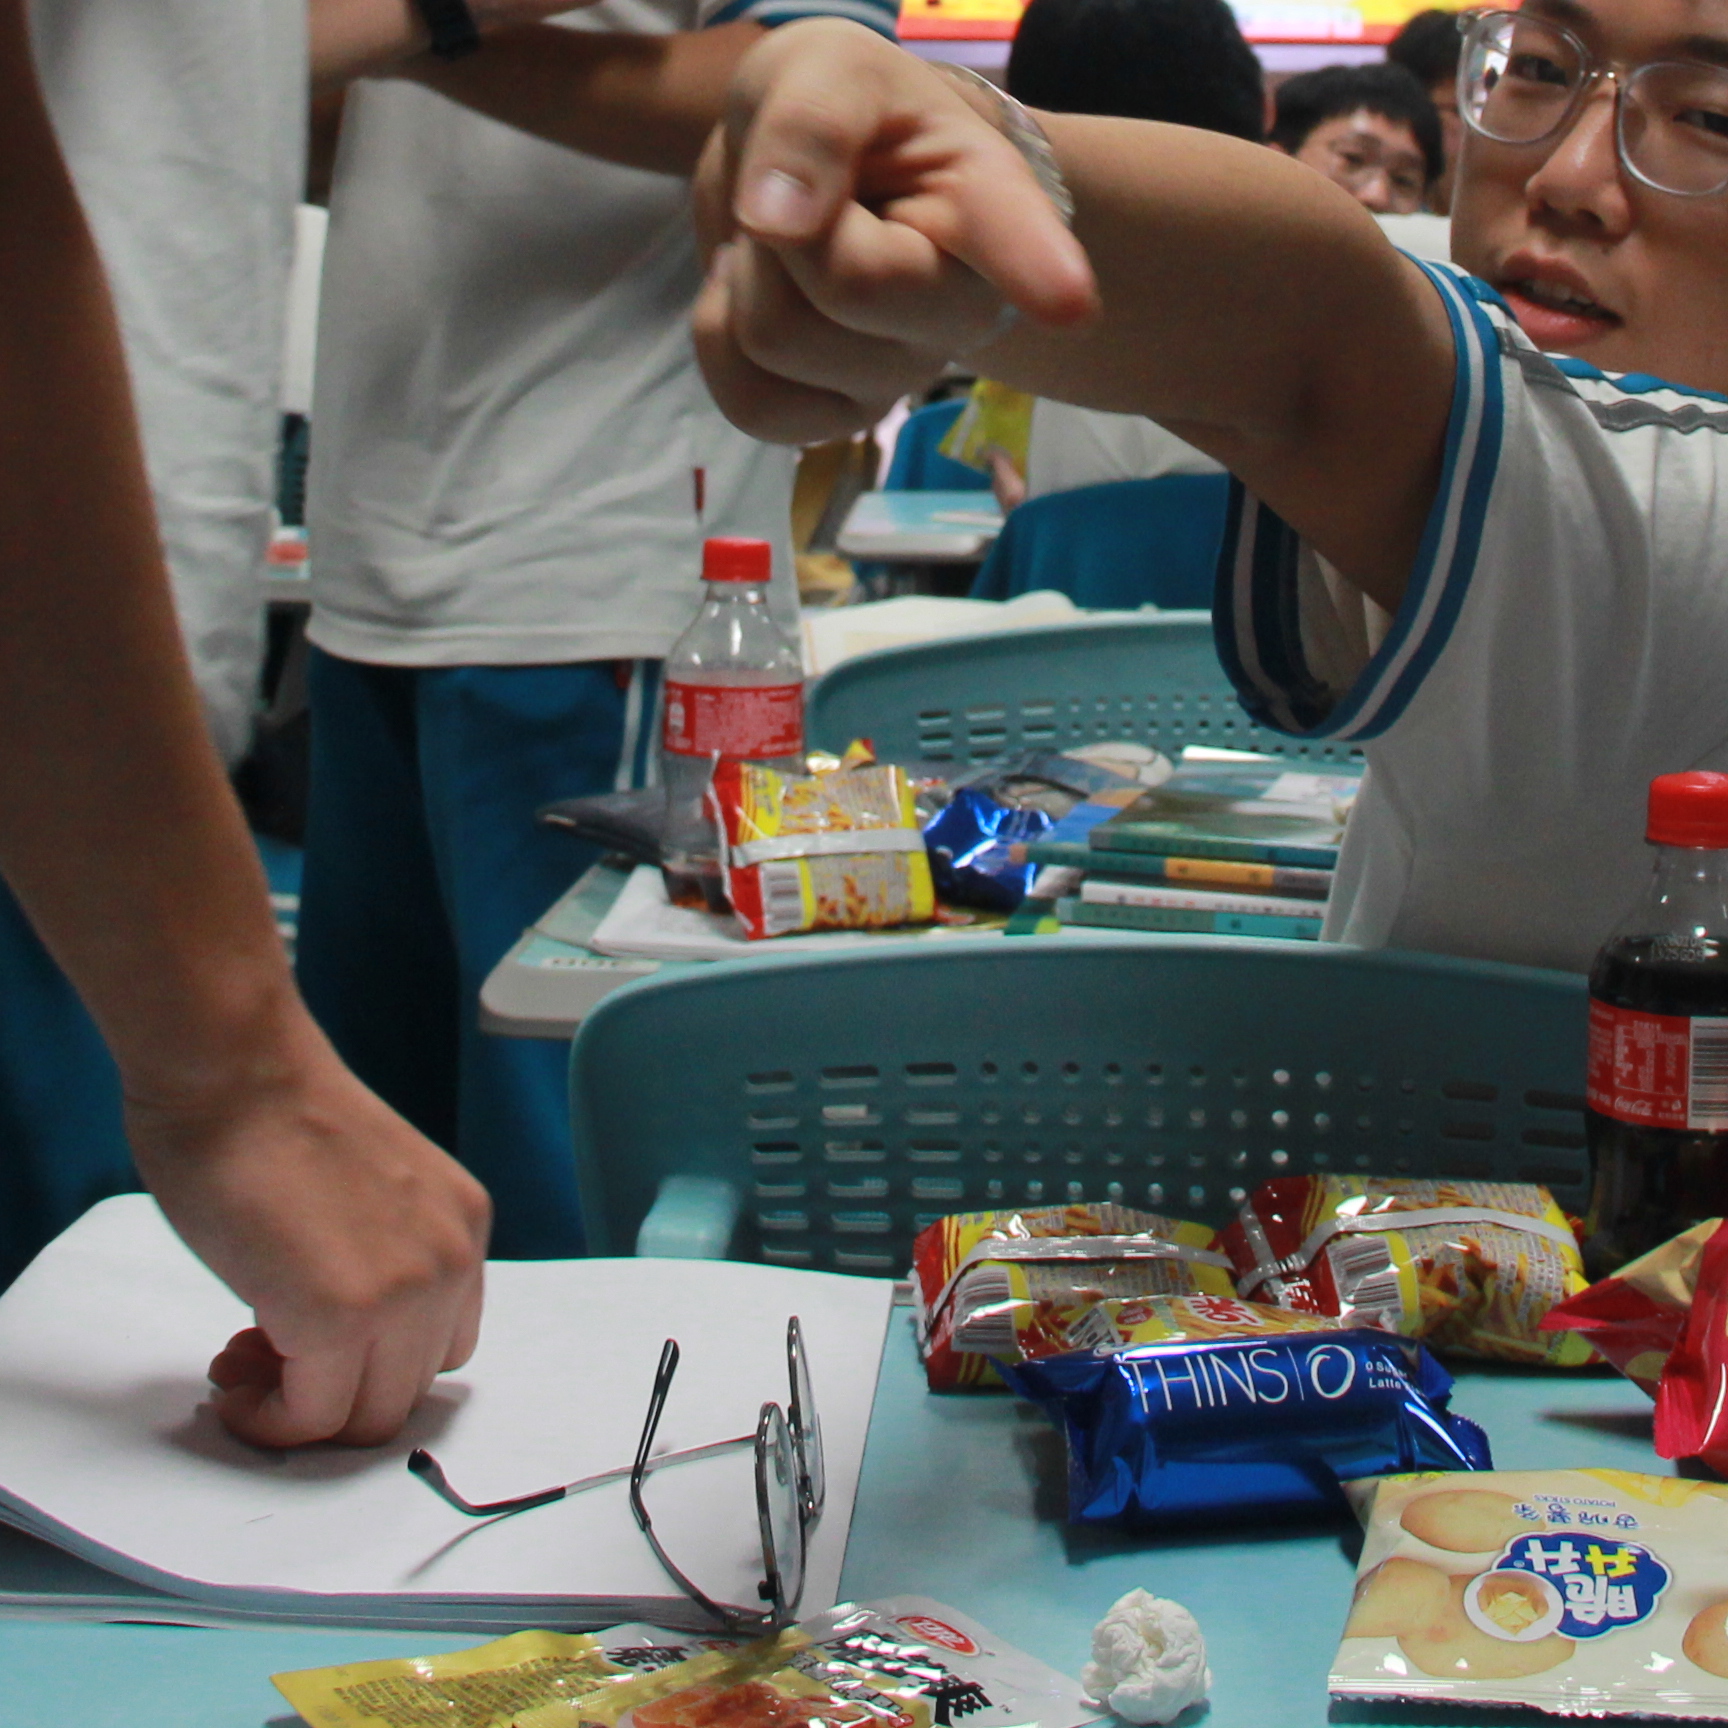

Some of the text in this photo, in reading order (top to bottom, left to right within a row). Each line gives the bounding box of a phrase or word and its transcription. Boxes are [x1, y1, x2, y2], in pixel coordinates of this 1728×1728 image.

[1122, 1348, 1290, 1414] THINS
[1368, 1377, 1402, 1390] Latte
[1533, 1493, 1616, 1509] POTATO STICKS
